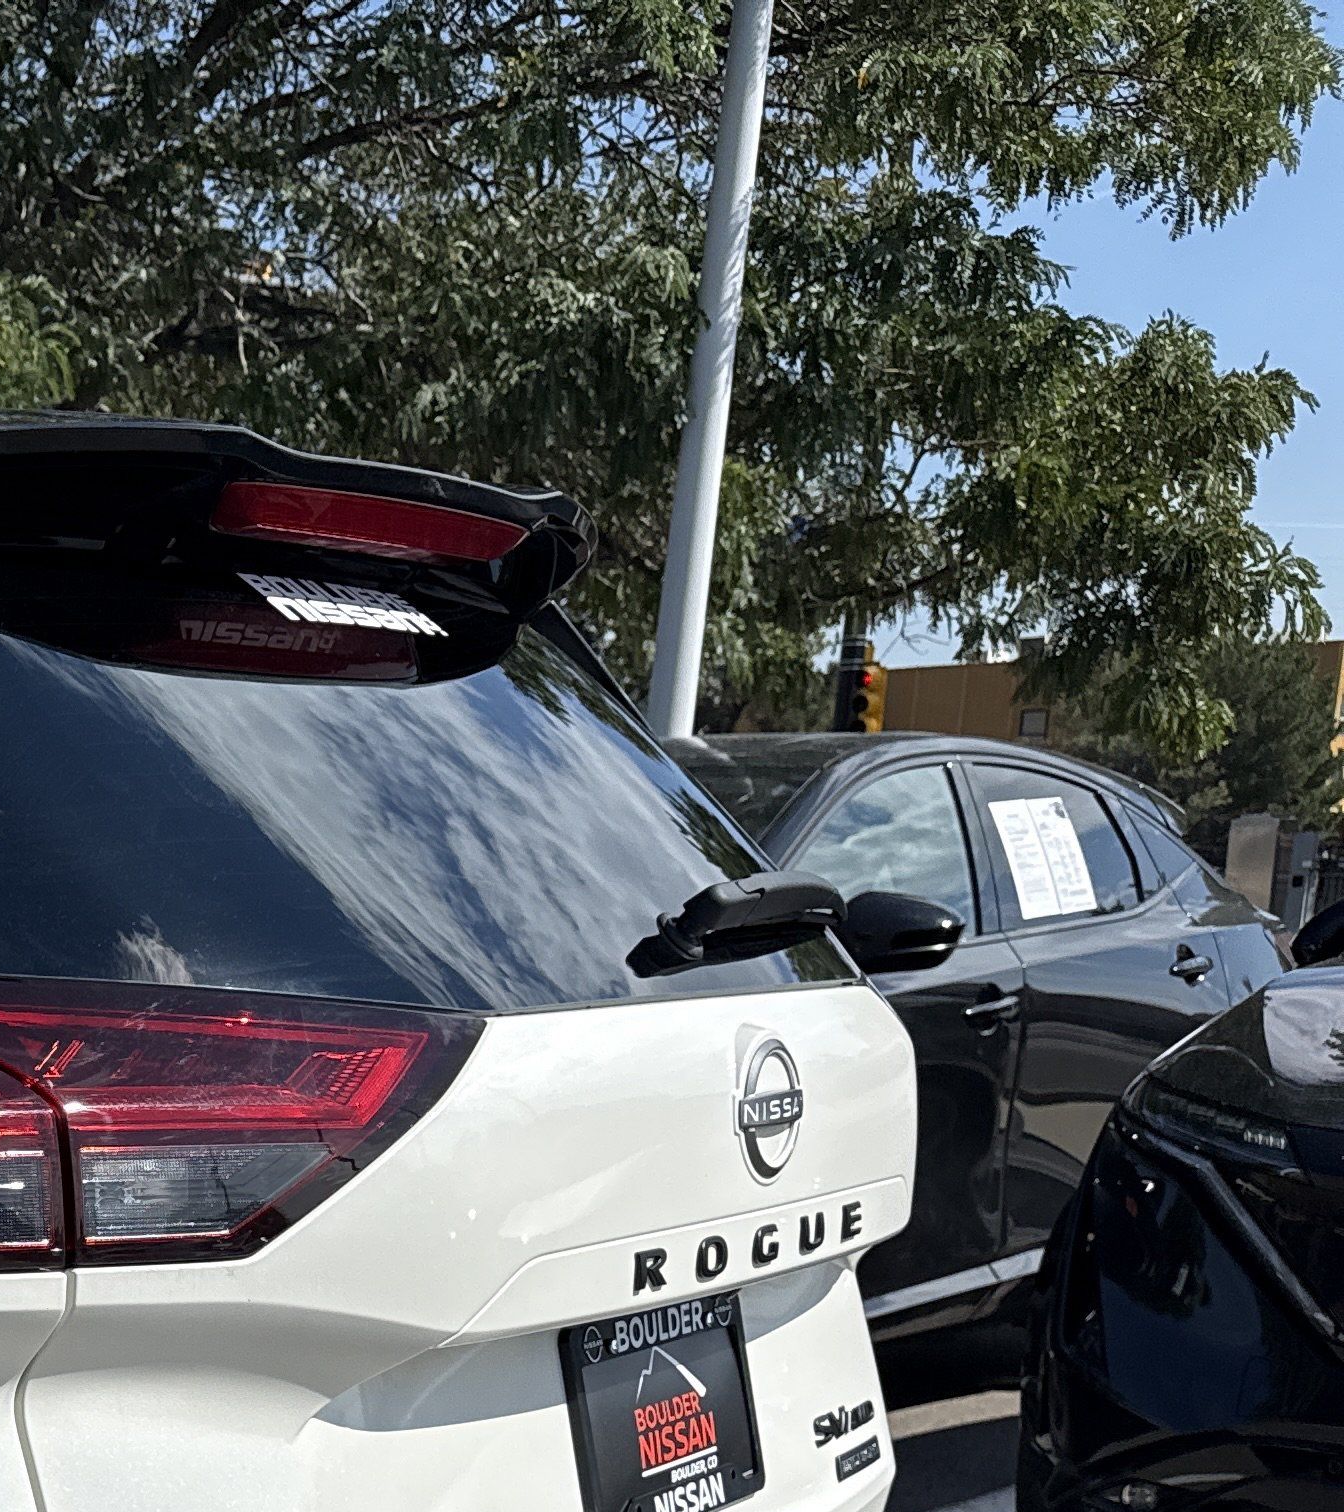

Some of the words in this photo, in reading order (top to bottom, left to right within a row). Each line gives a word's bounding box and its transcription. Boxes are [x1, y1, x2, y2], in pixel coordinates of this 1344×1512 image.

[236, 572, 404, 611] BOULDER
[743, 1096, 803, 1124] NISSA
[633, 1201, 863, 1296] ROGUE
[614, 1300, 704, 1353] BOULDER
[634, 1391, 701, 1432] BOULDER
[638, 1410, 716, 1469] NISSAN
